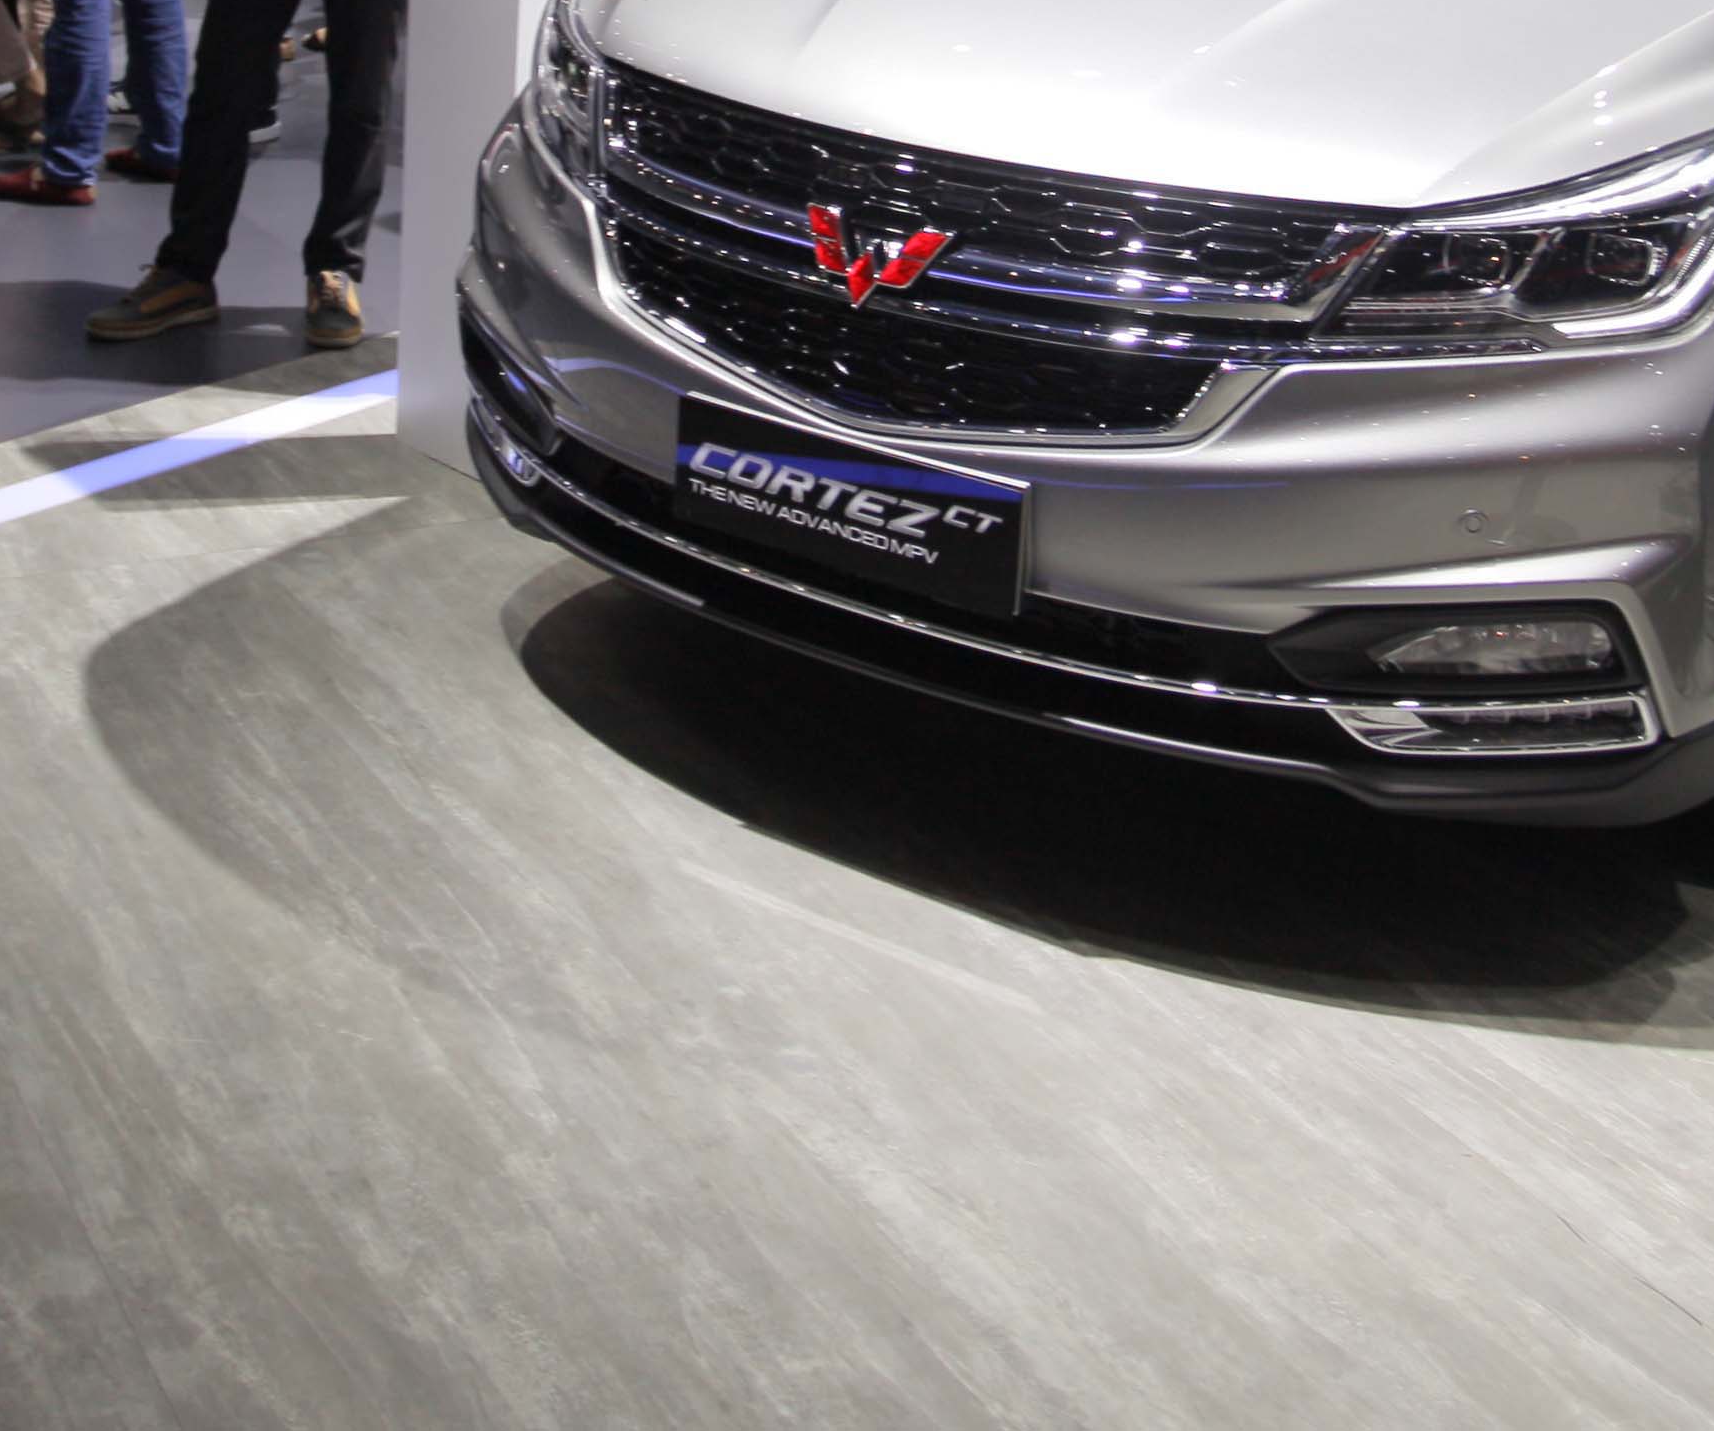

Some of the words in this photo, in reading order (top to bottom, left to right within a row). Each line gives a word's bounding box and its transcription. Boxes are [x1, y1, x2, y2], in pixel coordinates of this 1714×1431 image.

[689, 441, 942, 538] CORTEZ
[943, 504, 1004, 535] CT
[689, 477, 727, 502] THE
[726, 485, 779, 516] NEW
[776, 506, 889, 551] ADVANCED
[889, 539, 939, 565] MPV
